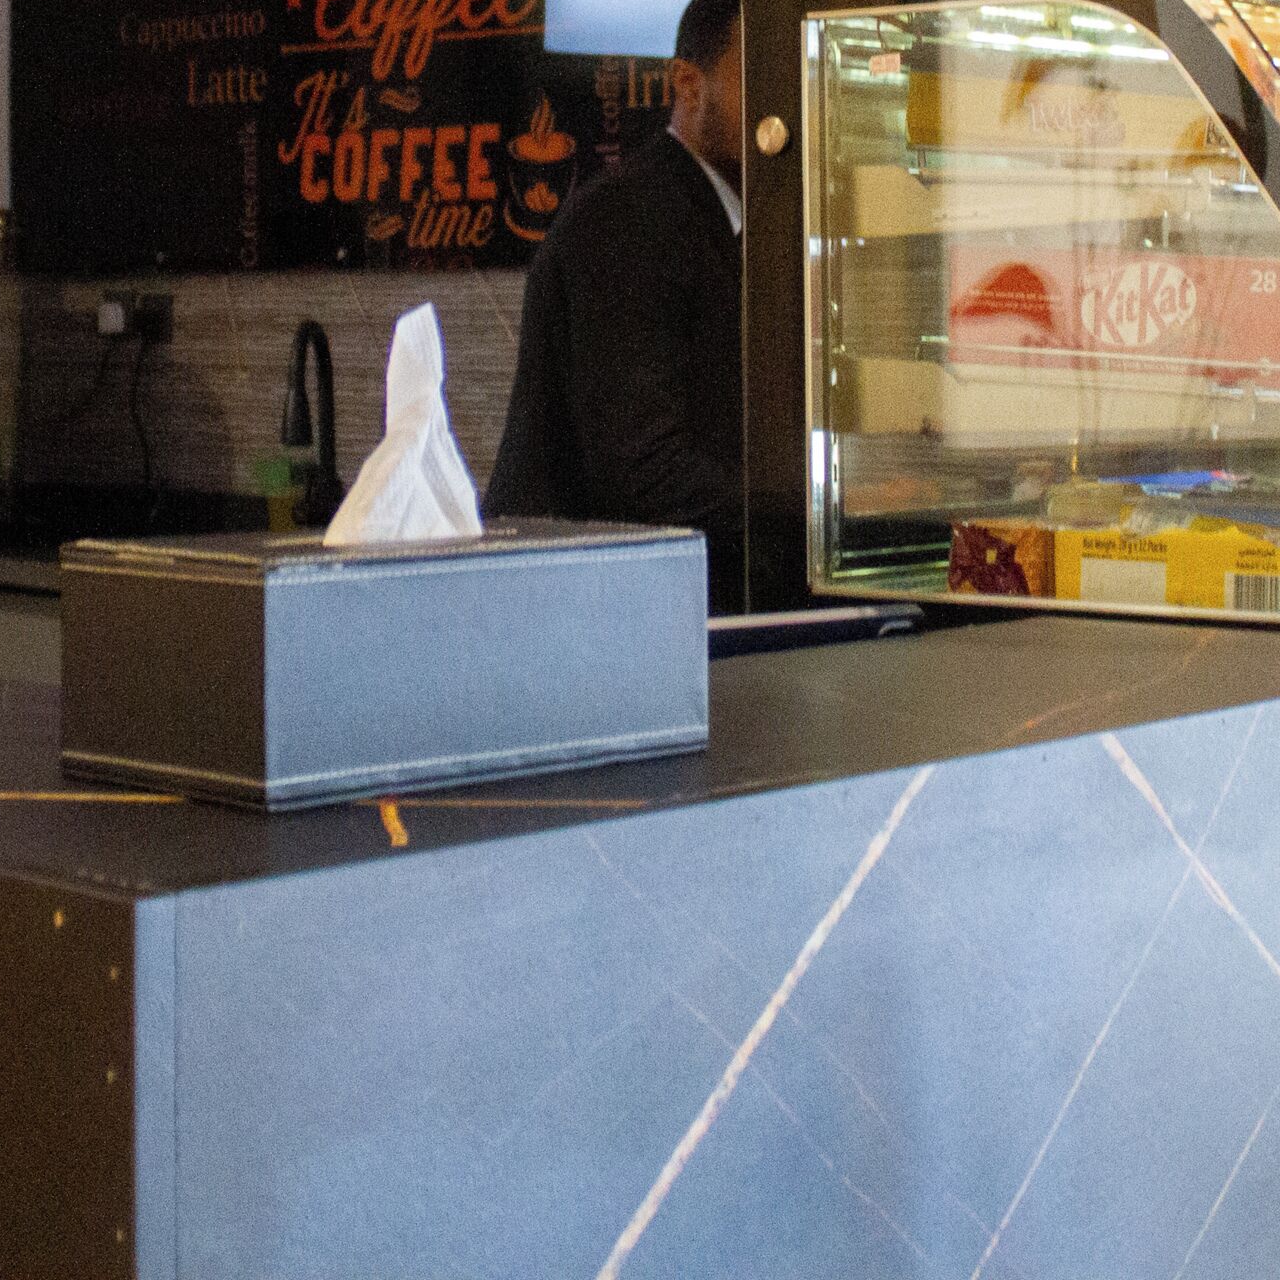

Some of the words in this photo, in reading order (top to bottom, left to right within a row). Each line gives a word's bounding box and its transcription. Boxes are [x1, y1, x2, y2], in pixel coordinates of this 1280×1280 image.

[119, 7, 267, 51] Cappuccino
[185, 58, 269, 106] Latte
[299, 123, 501, 203] COFFEE
[407, 188, 494, 248] time
[1092, 262, 1192, 344] KitKat
